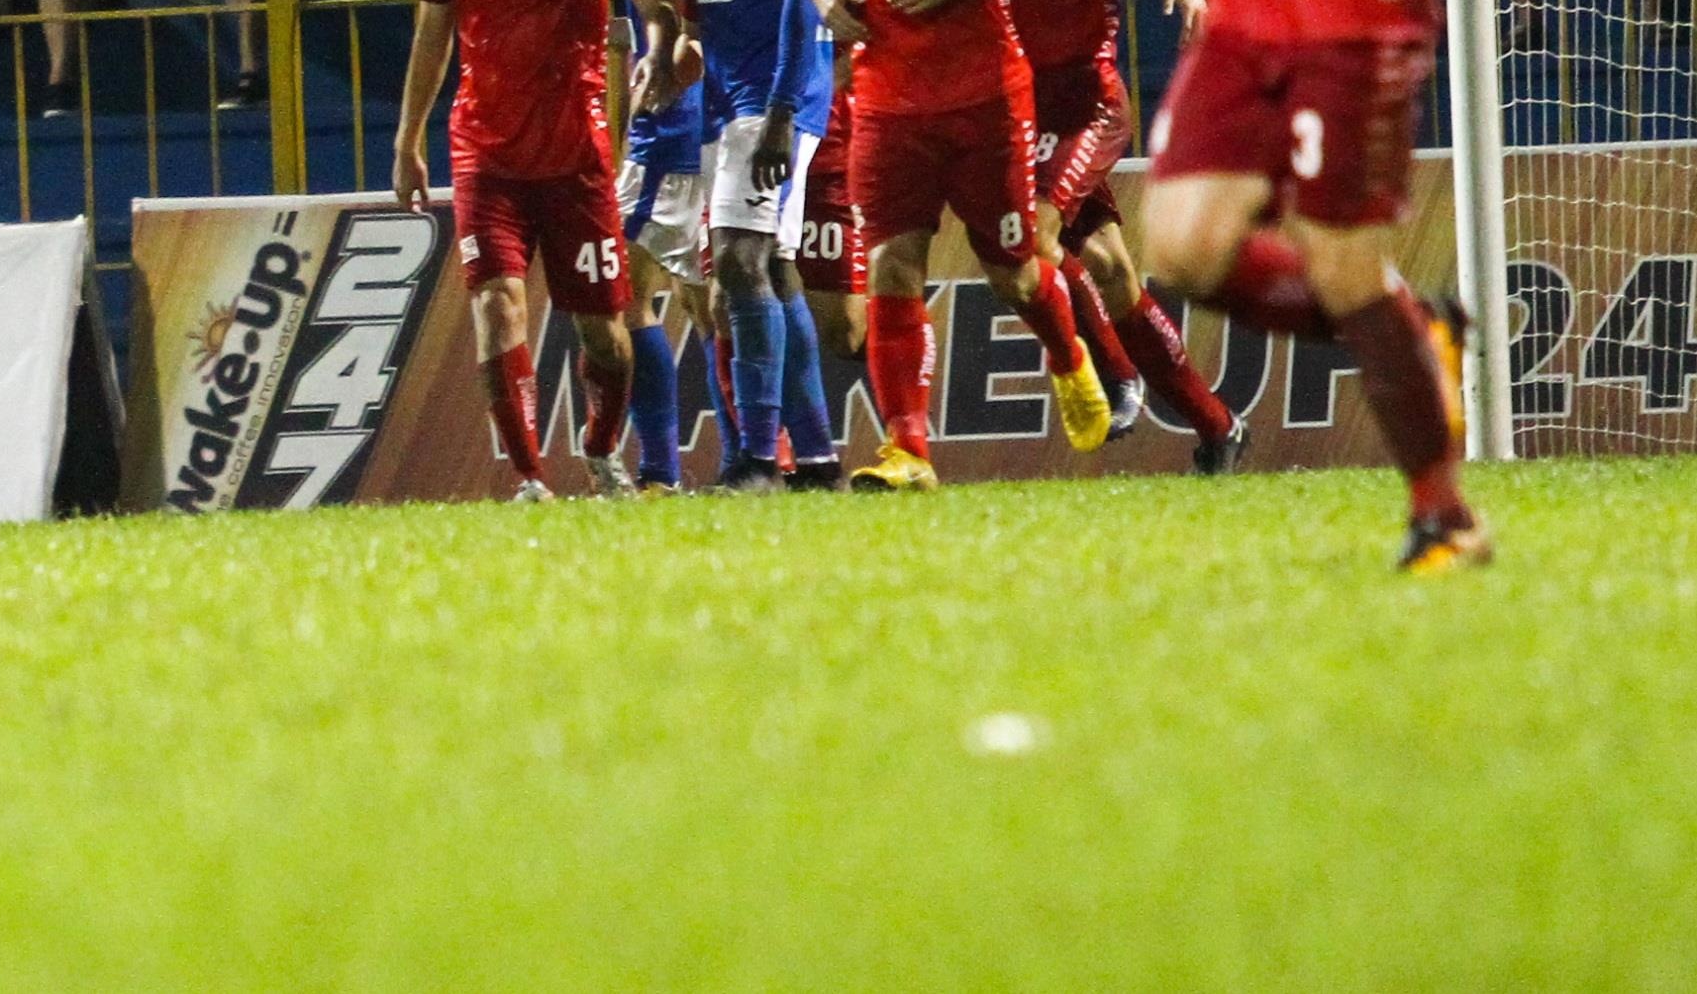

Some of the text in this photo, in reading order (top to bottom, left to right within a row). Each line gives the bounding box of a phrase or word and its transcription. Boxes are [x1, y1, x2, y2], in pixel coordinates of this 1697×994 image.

[1291, 109, 1324, 179] 3
[803, 220, 843, 261] 20
[1000, 211, 1023, 248] 8
[575, 238, 620, 283] 45
